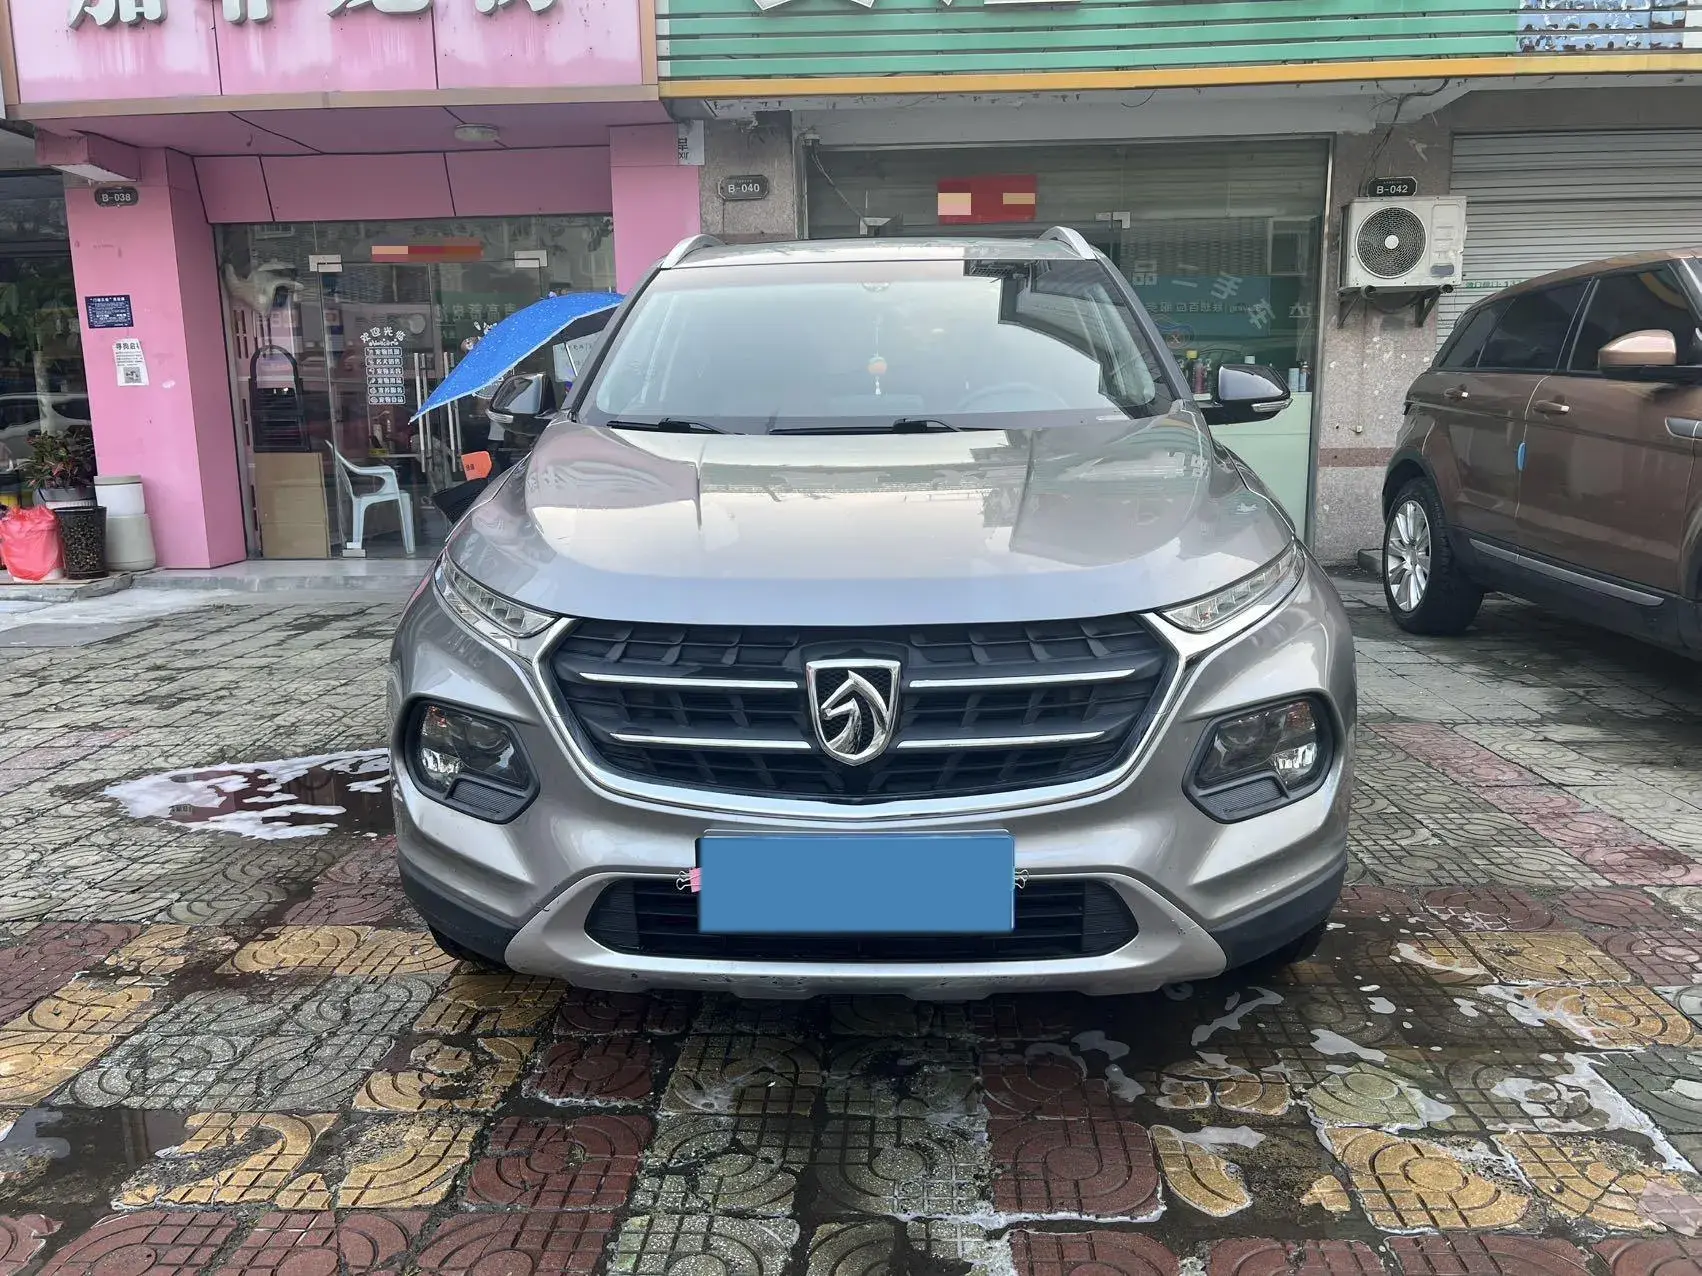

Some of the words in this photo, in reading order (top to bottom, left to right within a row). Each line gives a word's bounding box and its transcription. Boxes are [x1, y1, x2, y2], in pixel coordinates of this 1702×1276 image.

[728, 183, 760, 193] B-040
[1376, 185, 1408, 194] B-042
[101, 193, 131, 202] B-038
[360, 326, 405, 343] 欢迎光临
